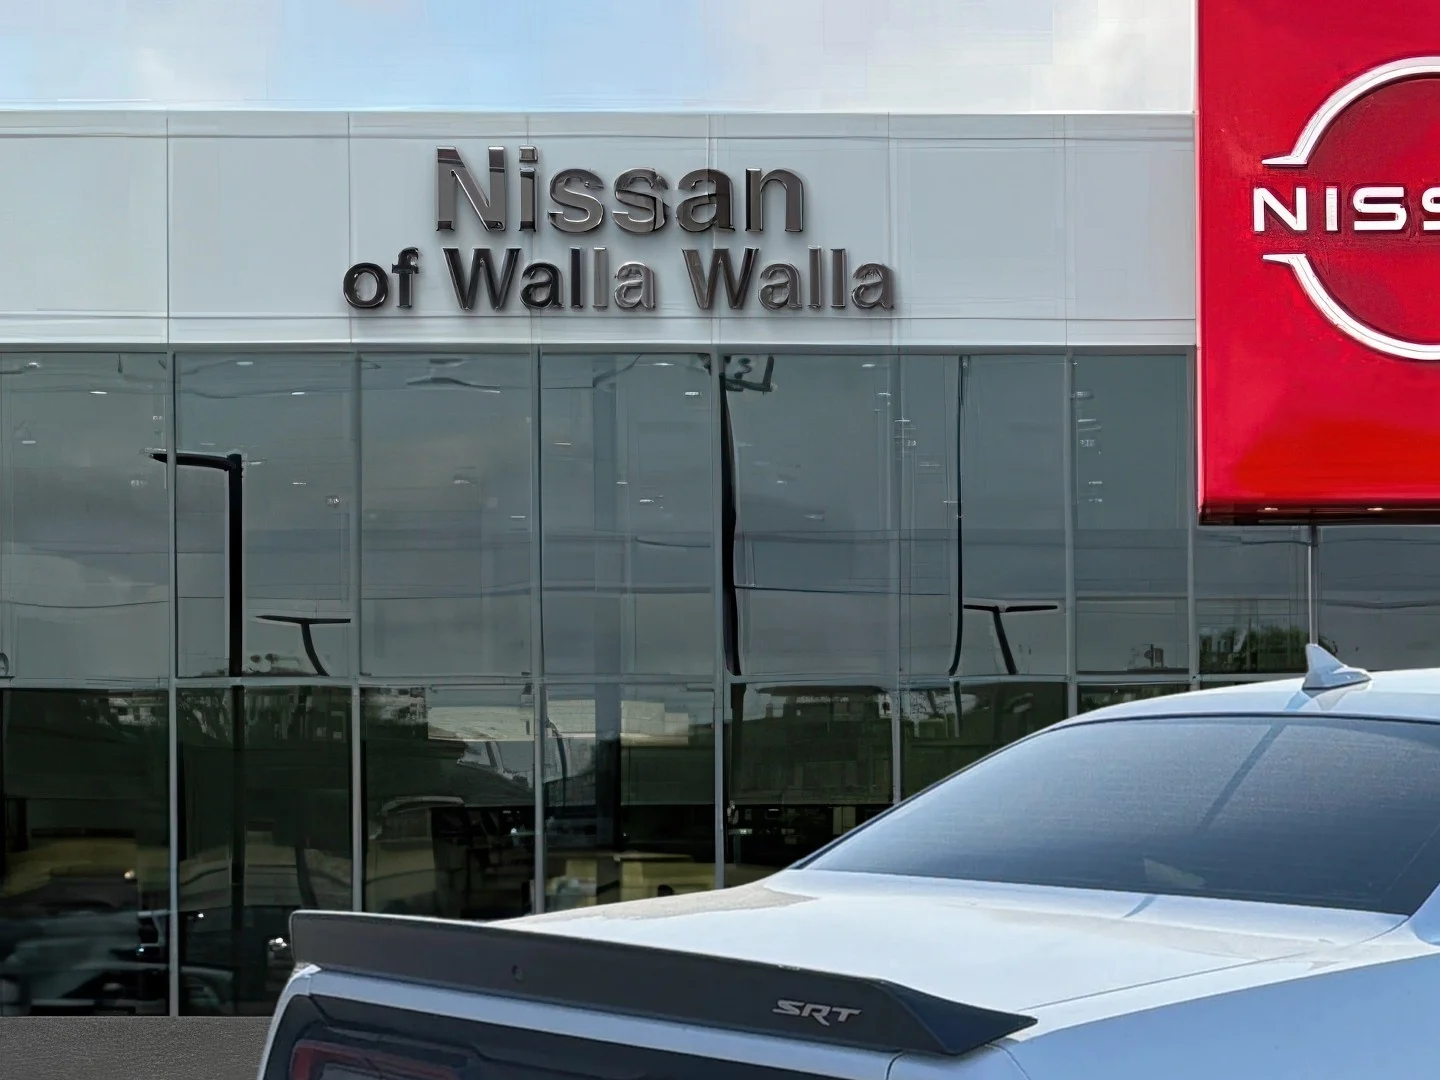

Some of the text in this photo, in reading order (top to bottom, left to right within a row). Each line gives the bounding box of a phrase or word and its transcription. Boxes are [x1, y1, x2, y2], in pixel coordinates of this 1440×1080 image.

[435, 146, 804, 233] Nissan
[342, 246, 895, 310] of Walla Walla
[772, 999, 862, 1026] SRT
